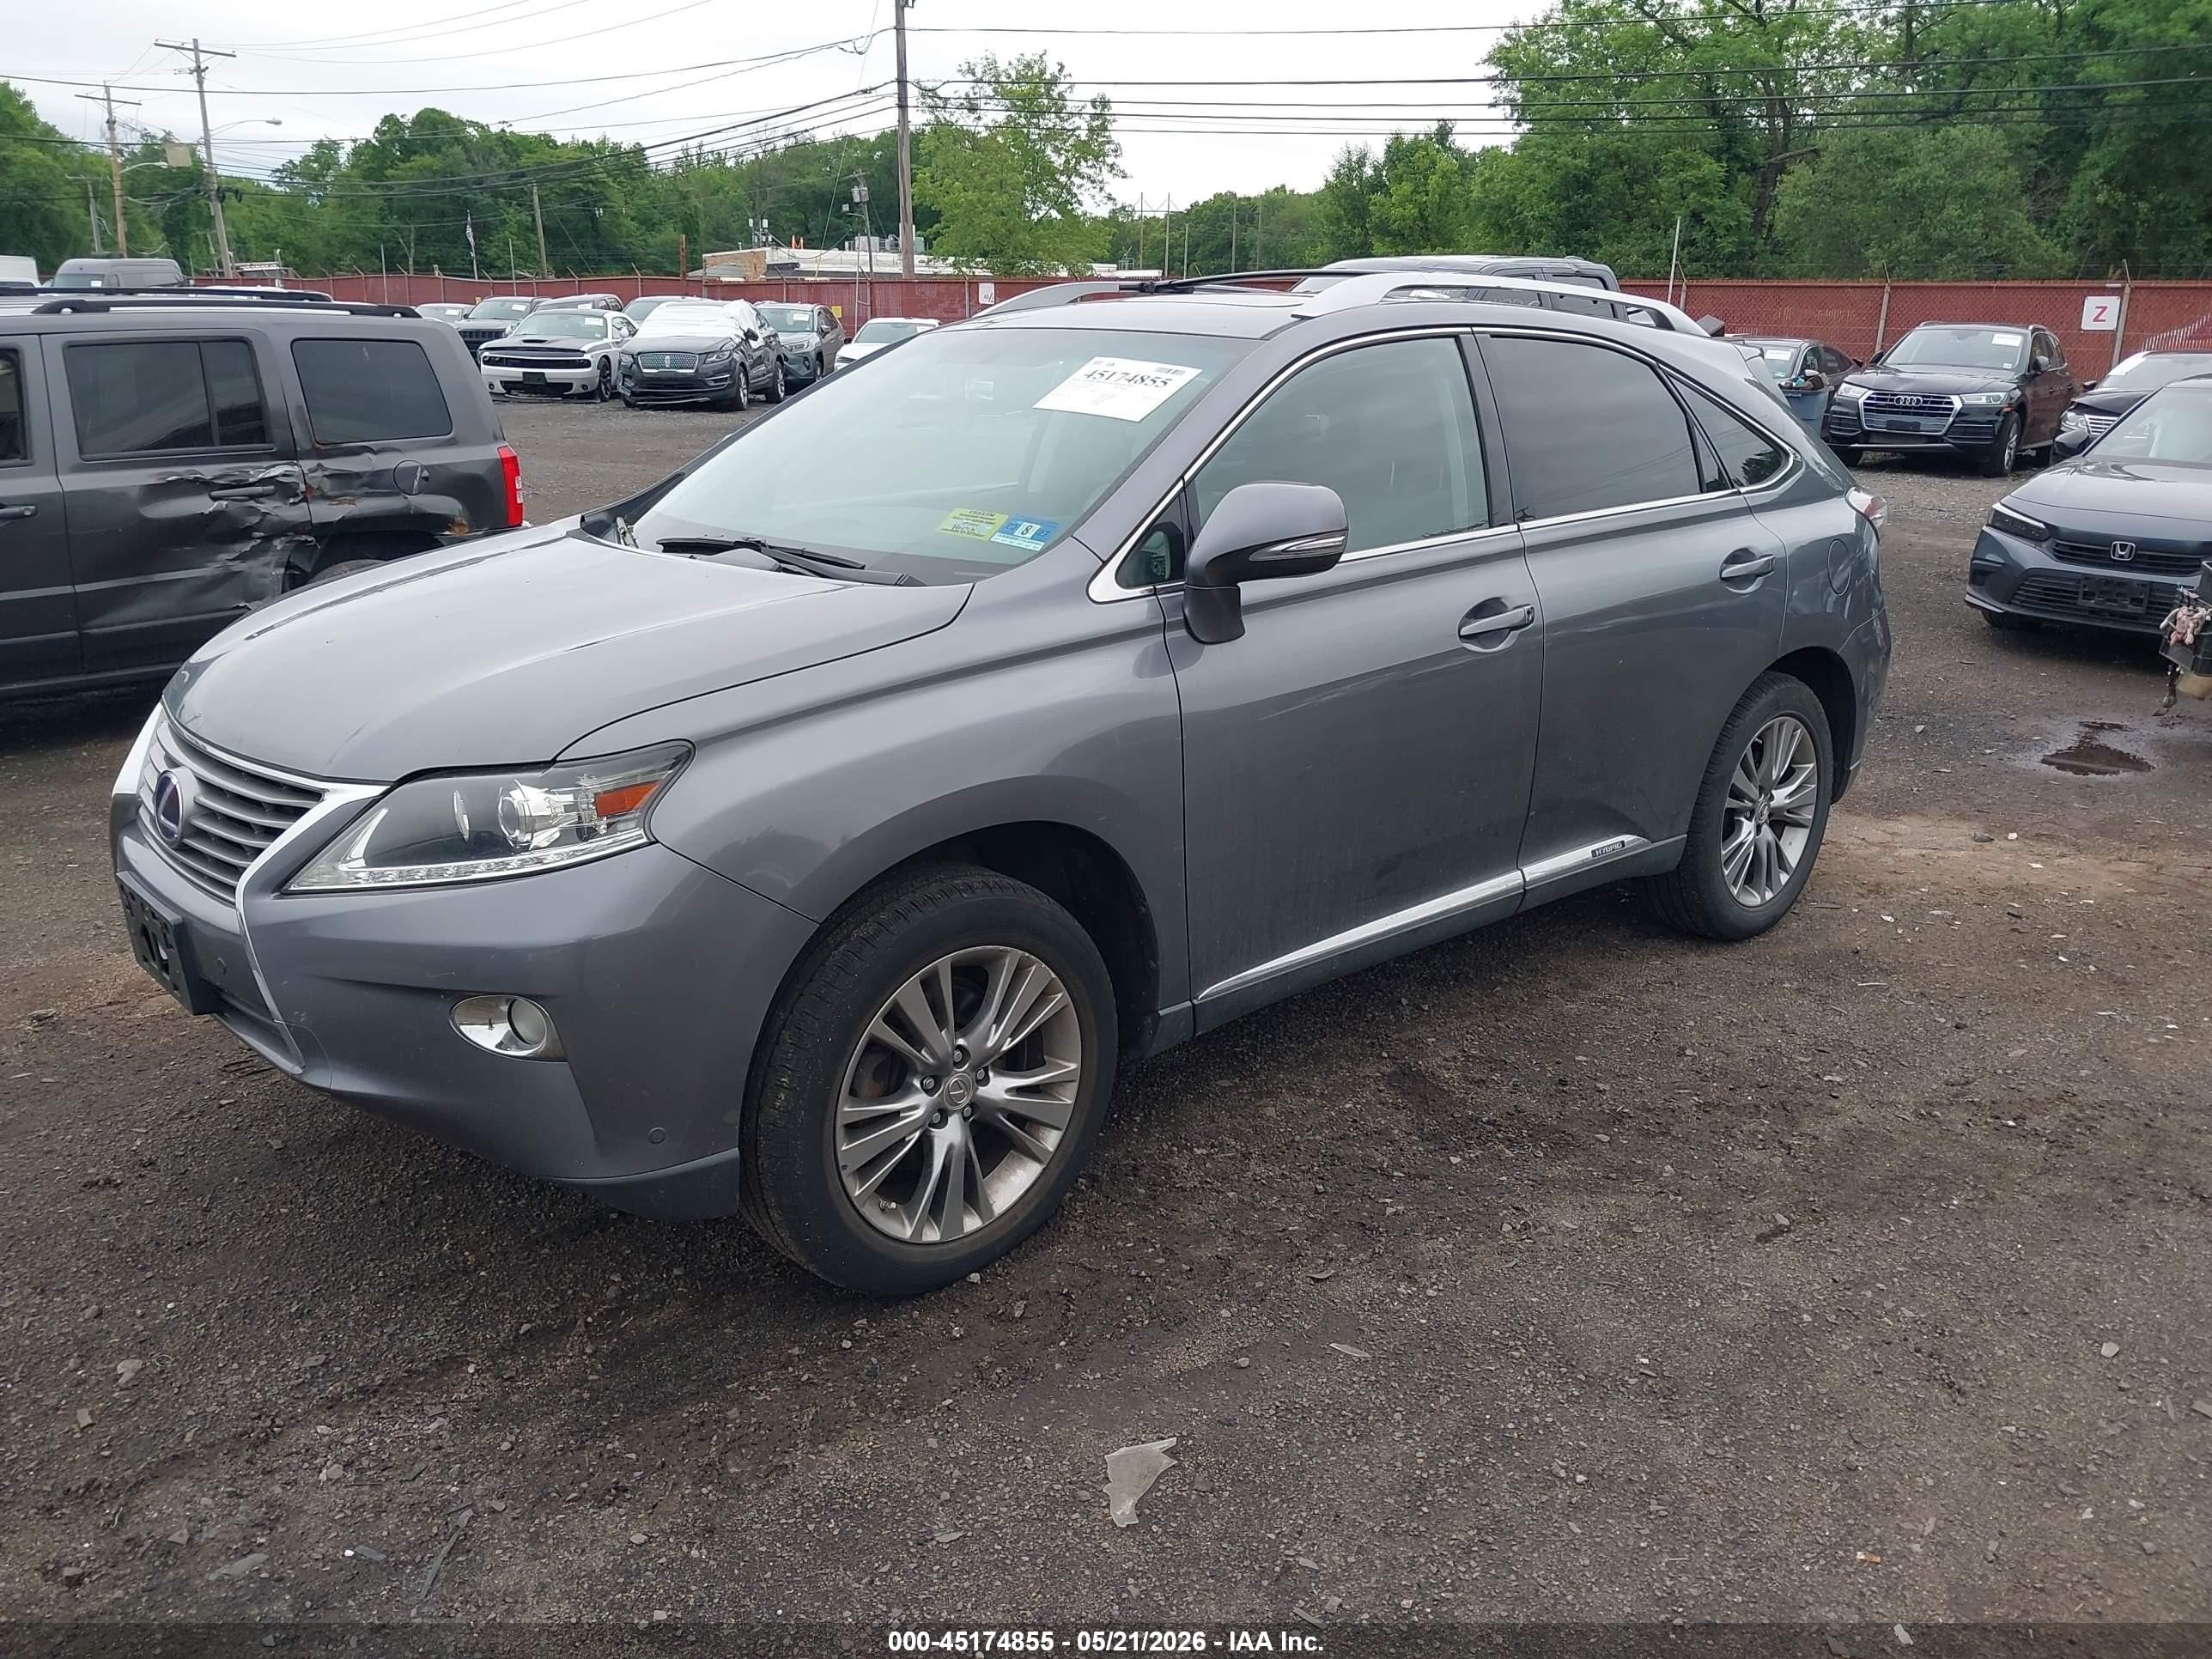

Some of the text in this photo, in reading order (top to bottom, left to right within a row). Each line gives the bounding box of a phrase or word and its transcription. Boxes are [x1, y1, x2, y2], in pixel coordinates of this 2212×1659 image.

[2093, 306, 2108, 322] Z
[1084, 369, 1174, 387] 45174855
[1020, 525, 1033, 536] 8
[1595, 842, 1622, 855] HYBRID
